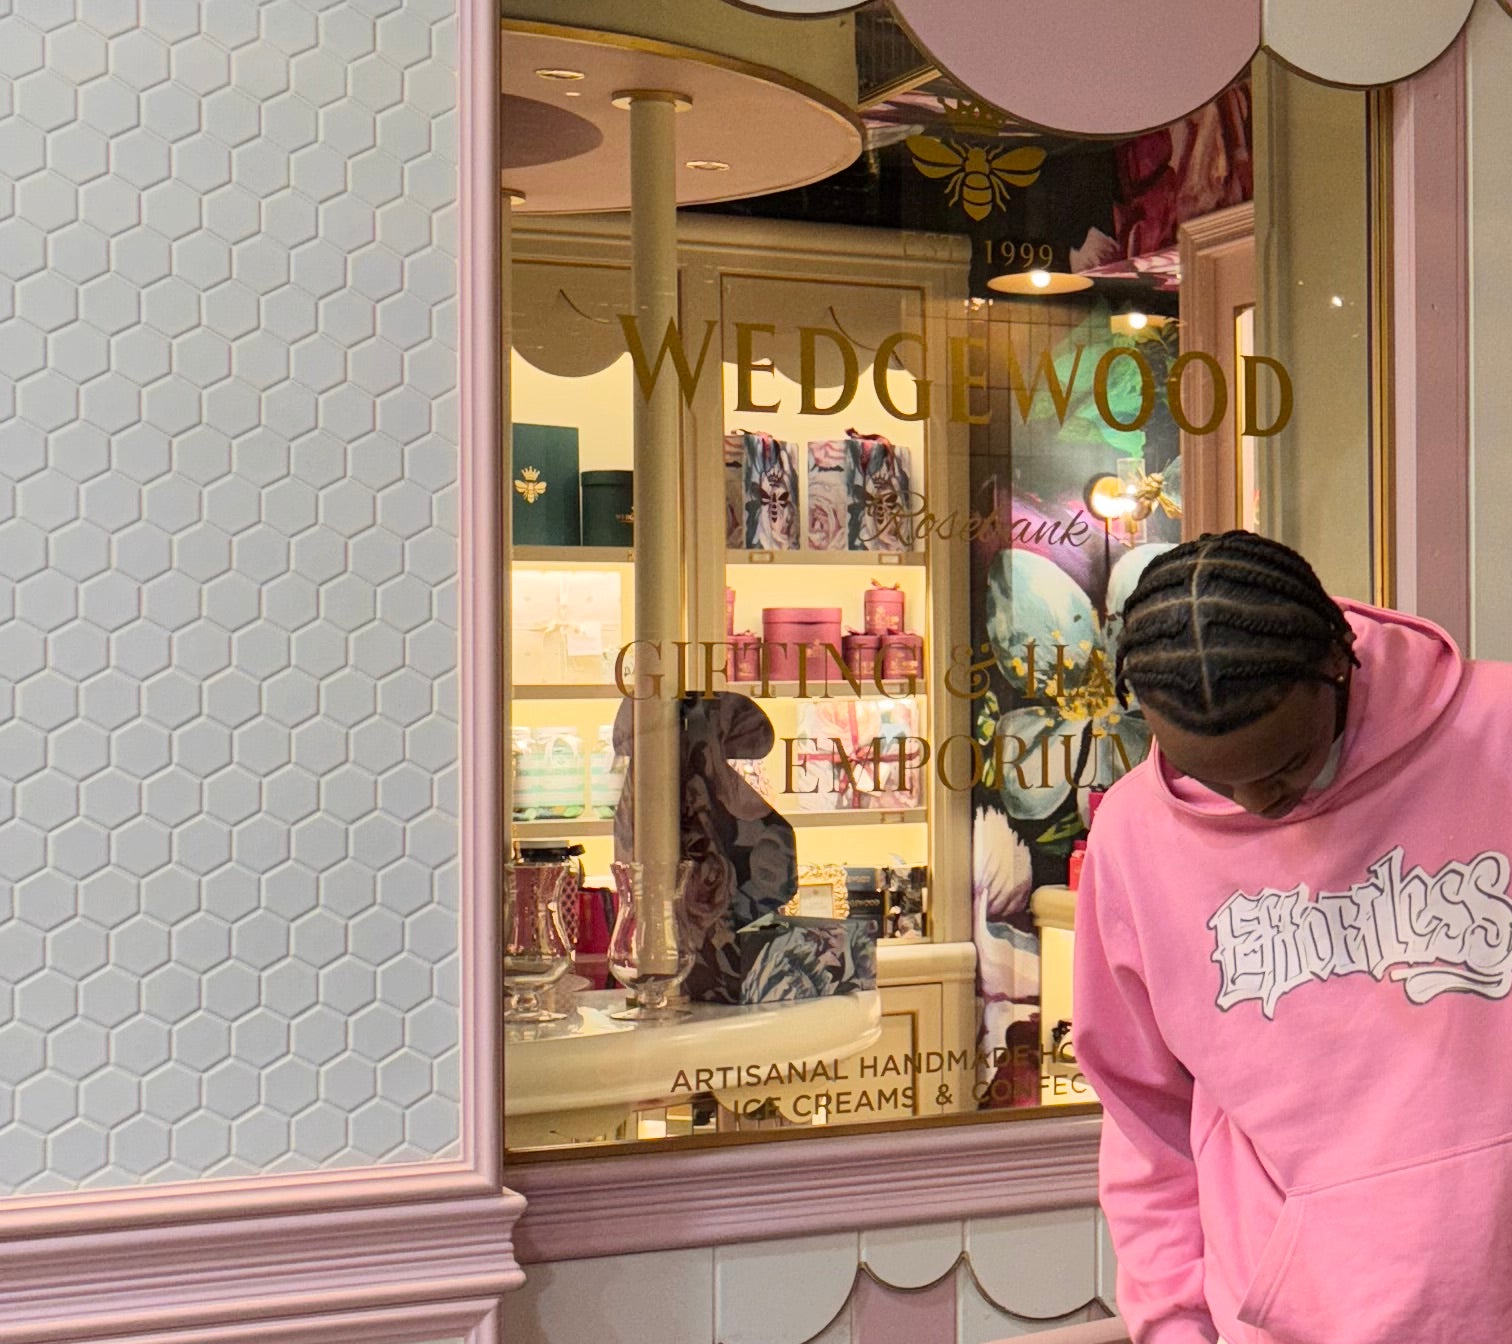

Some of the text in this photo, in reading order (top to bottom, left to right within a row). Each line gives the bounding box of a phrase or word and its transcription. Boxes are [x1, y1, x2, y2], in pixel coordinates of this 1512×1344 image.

[985, 240, 1054, 270] 1999
[616, 313, 1294, 439] WEDGEWOOD
[614, 639, 1117, 701] GIFTING & HA
[670, 1041, 1079, 1093] ARTISANAL HANDMADE HO
[733, 1072, 1088, 1120] ICE CREAMS & CONFEC
